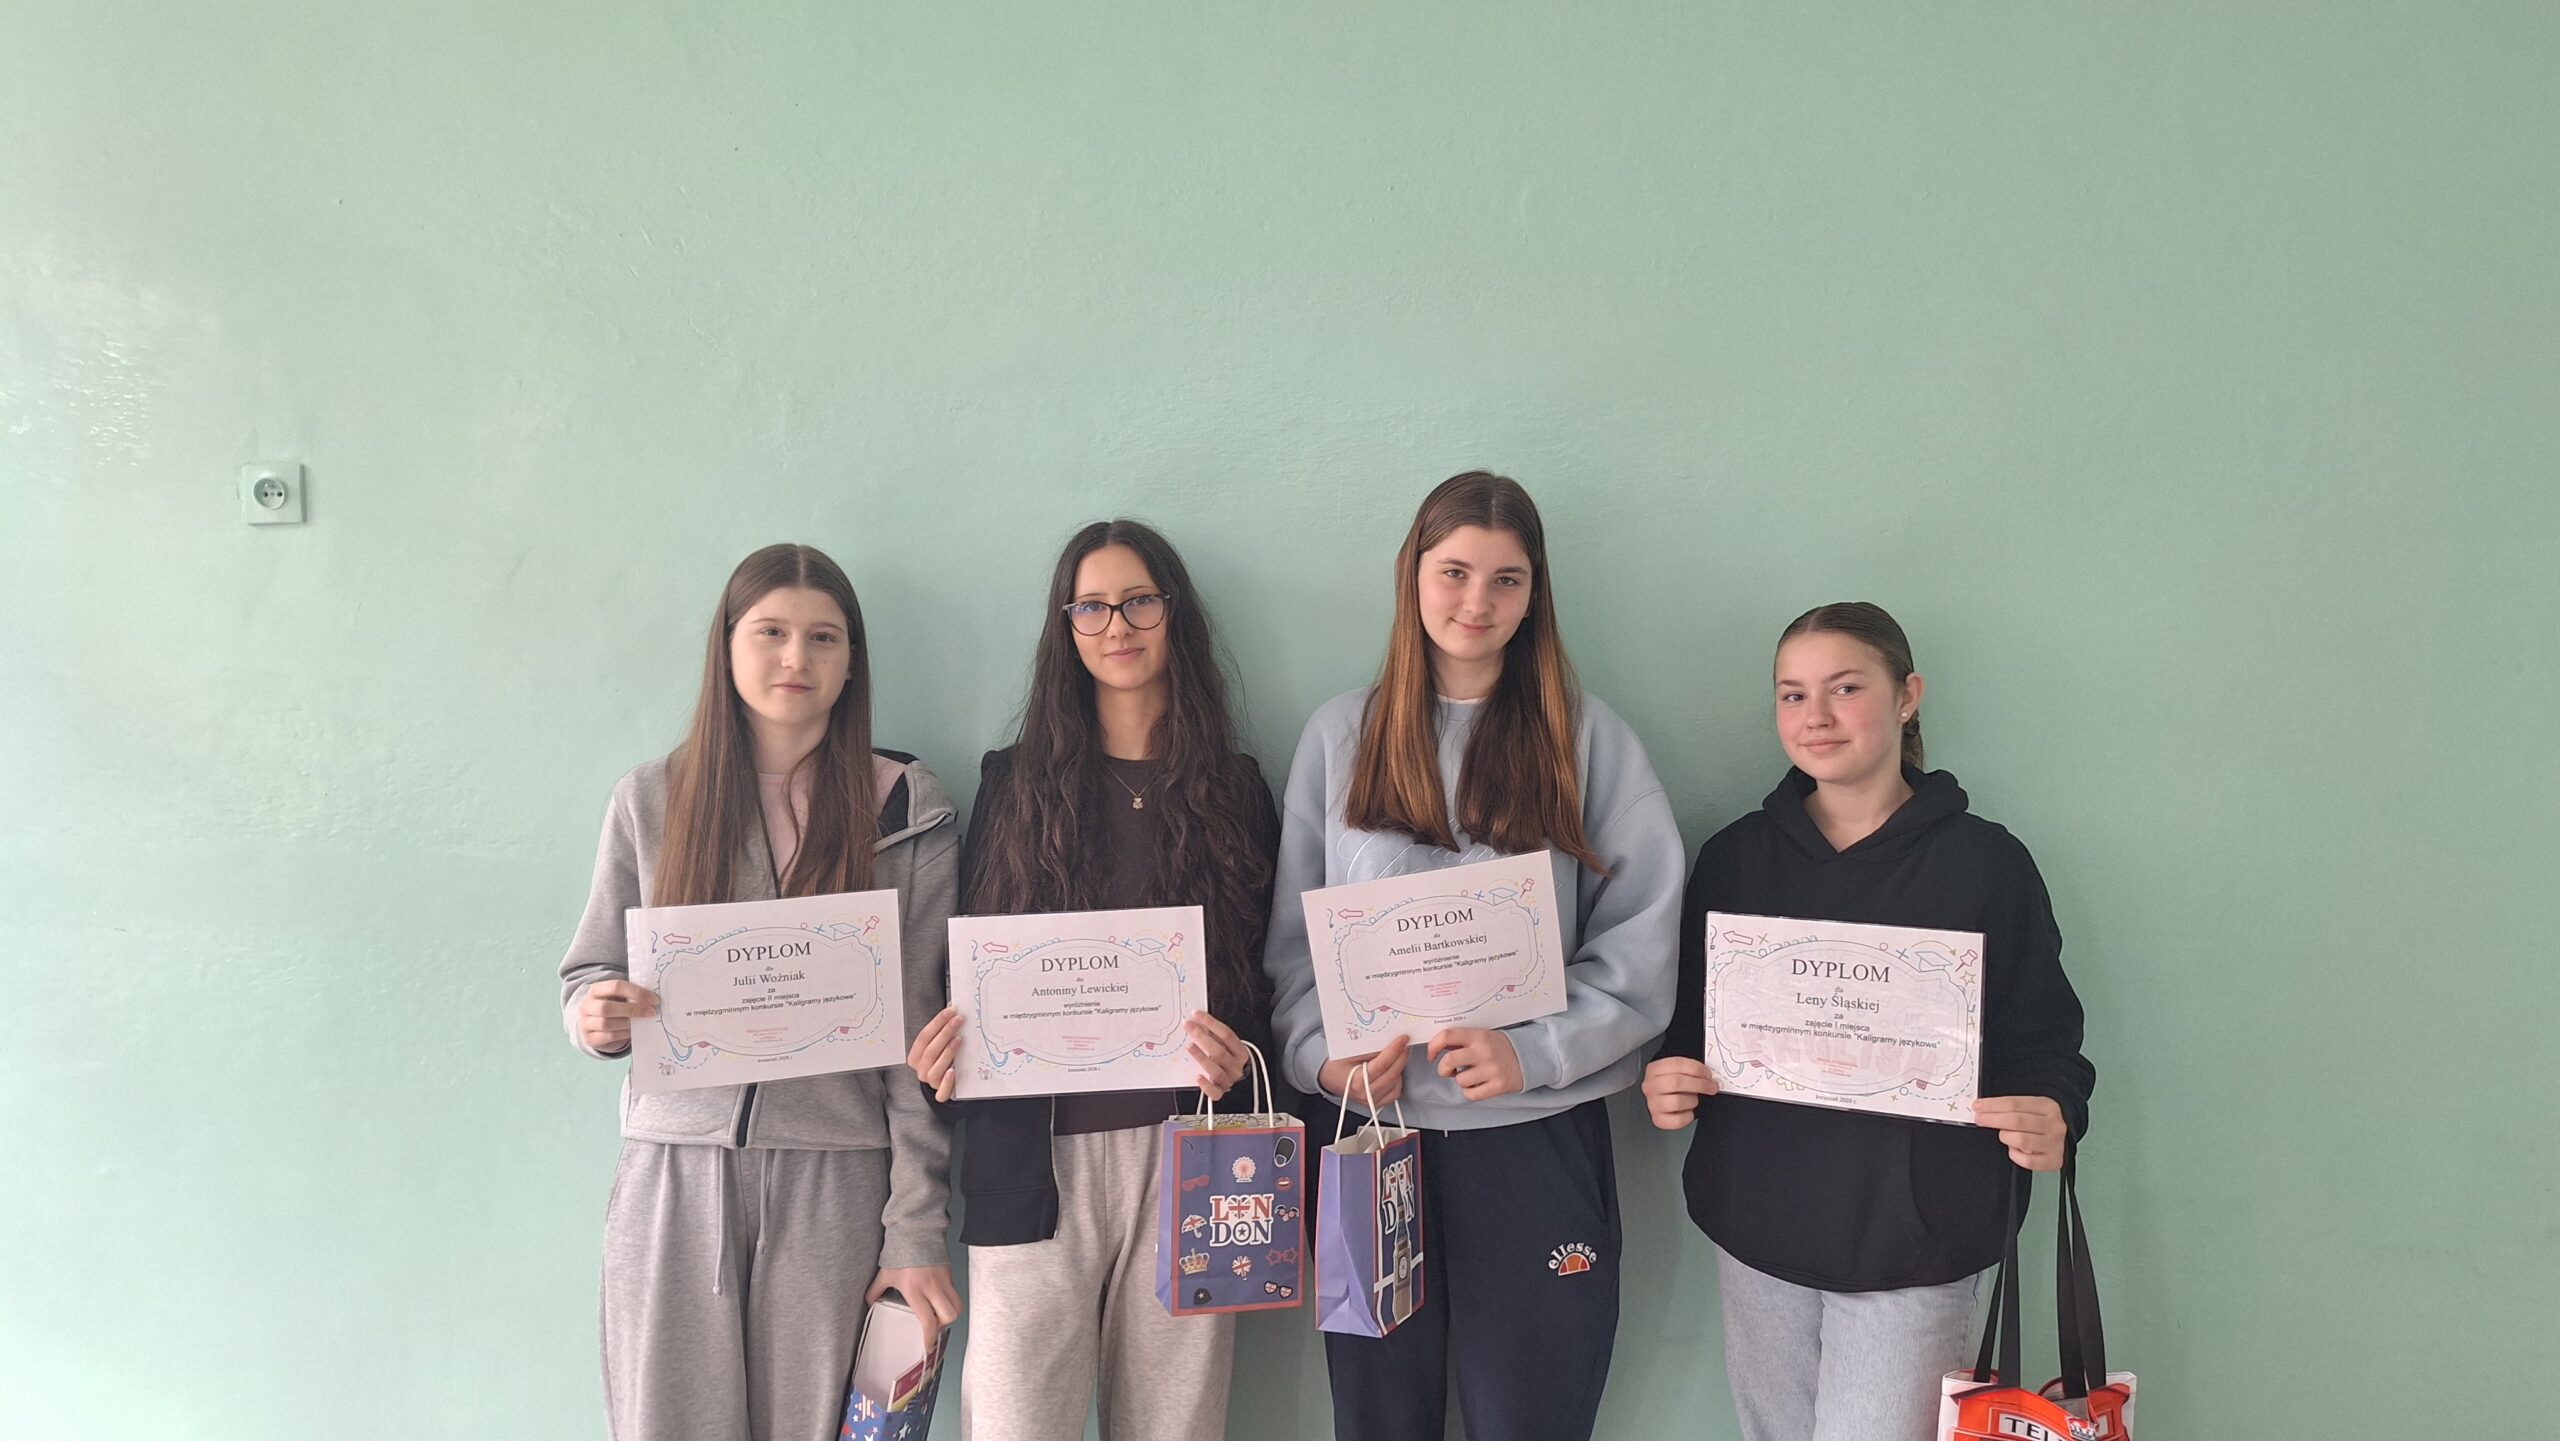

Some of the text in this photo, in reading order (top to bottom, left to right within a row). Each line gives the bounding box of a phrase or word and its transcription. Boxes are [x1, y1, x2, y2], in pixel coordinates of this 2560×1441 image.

[1397, 908, 1474, 932] DYPLOM
[727, 941, 811, 963] DYPLOM
[1389, 932, 1488, 956] Amelii Bartkowskiej
[1041, 955, 1120, 973] DYPLOM
[1423, 963, 1453, 973] konkursie
[1791, 959, 1891, 983] DYPLOM
[733, 976, 756, 987] Julii
[1031, 982, 1129, 997] Antoniny Lewickiej
[742, 996, 766, 1005] zajęcie
[774, 993, 800, 1001] miejsca
[1796, 992, 1880, 1013] Leny Śląskiej
[694, 1005, 750, 1016] międzygminnym
[751, 1002, 784, 1011] konkursie
[1062, 1008, 1092, 1016] konkursie
[1749, 1023, 1812, 1036] międzygminnym
[1813, 1029, 1852, 1039] konkursie
[1854, 1033, 1897, 1046] "Kaligramy
[1805, 1020, 1832, 1029] zajęcie
[1839, 1024, 1870, 1032] miejsca
[1211, 1219, 1273, 1245] DON
[1548, 1242, 1597, 1270] ellesse
